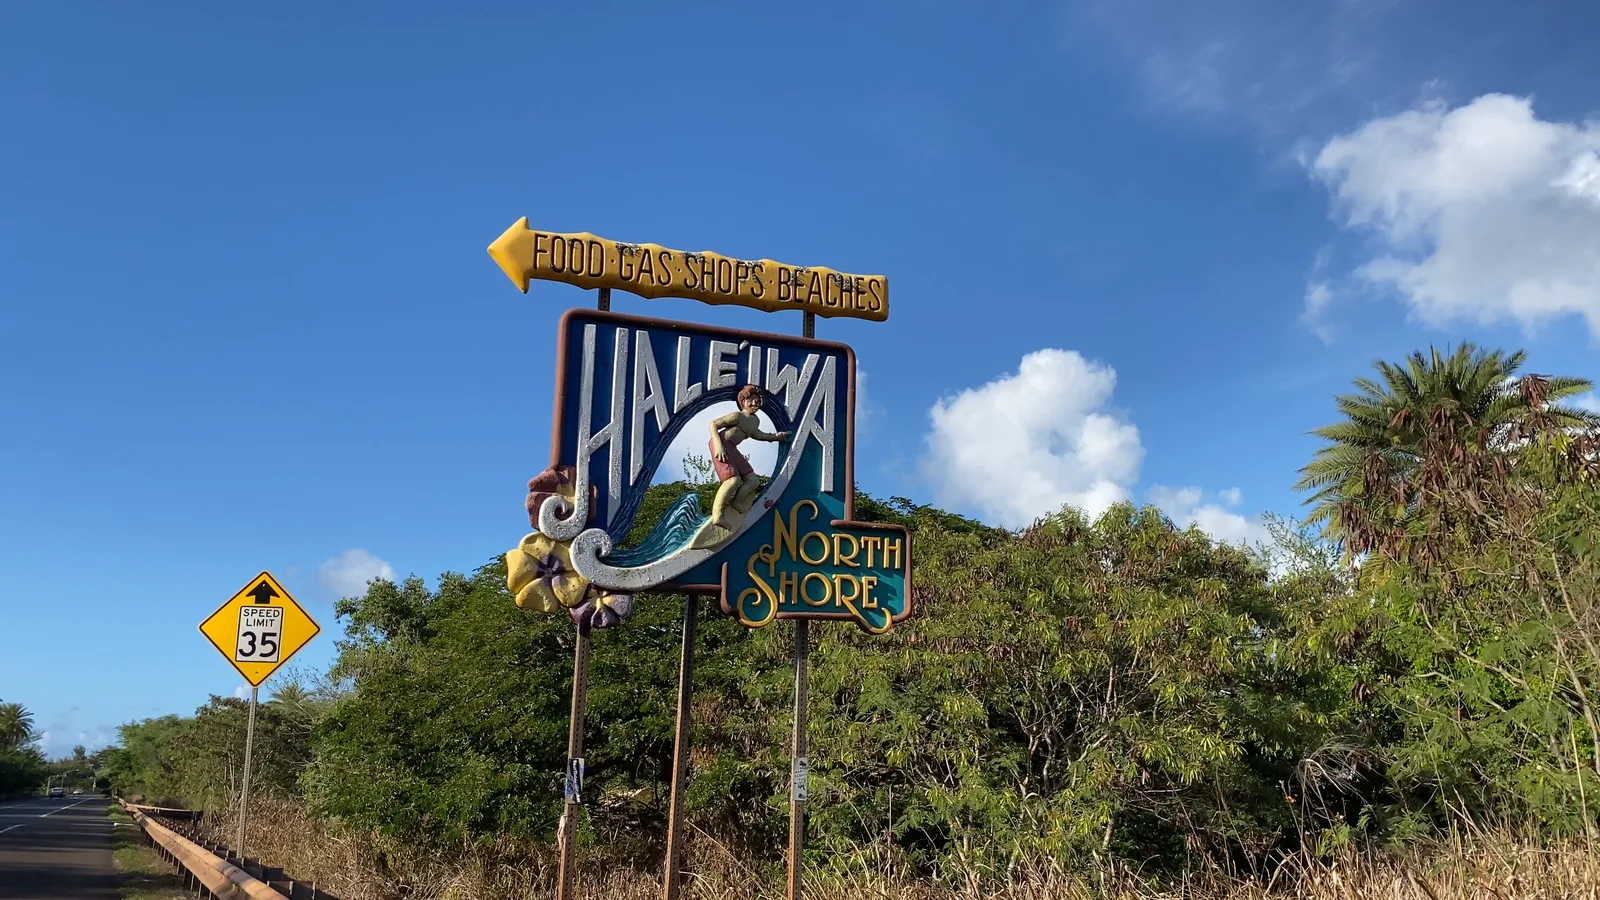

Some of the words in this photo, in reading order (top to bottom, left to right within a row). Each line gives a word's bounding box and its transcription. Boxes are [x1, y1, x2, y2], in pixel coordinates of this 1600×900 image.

[533, 233, 605, 278] FOOD
[618, 244, 673, 287] GAS
[682, 252, 765, 299] SHOPS
[778, 267, 882, 312] BEACHES
[759, 499, 902, 569] NORTH
[243, 609, 280, 617] SPEED
[737, 552, 892, 633] SHORE
[238, 631, 277, 657] 35
[246, 618, 275, 627] LIMIT
